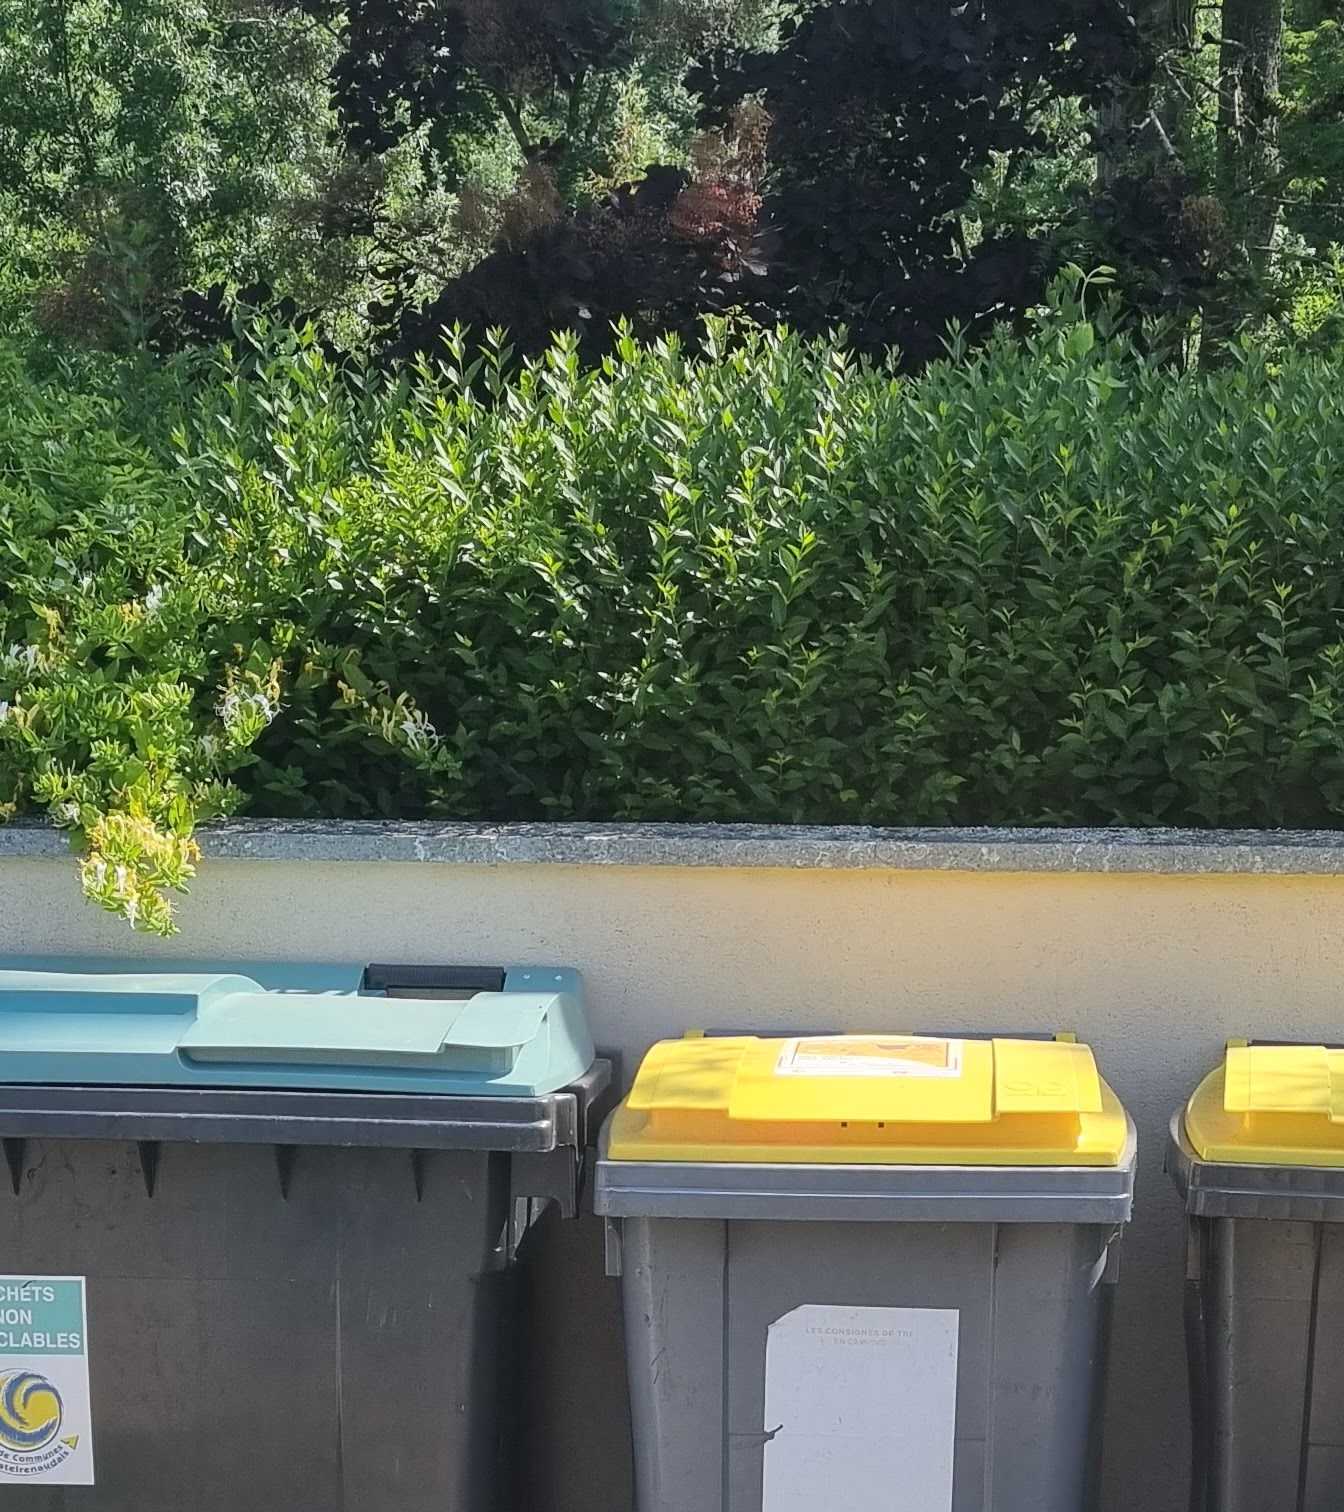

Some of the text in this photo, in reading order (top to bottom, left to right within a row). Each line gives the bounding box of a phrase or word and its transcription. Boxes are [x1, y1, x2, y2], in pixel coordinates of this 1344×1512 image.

[825, 1327, 879, 1337] CONSIGNES
[882, 1328, 894, 1337] DE
[13, 1444, 64, 1463] Communes
